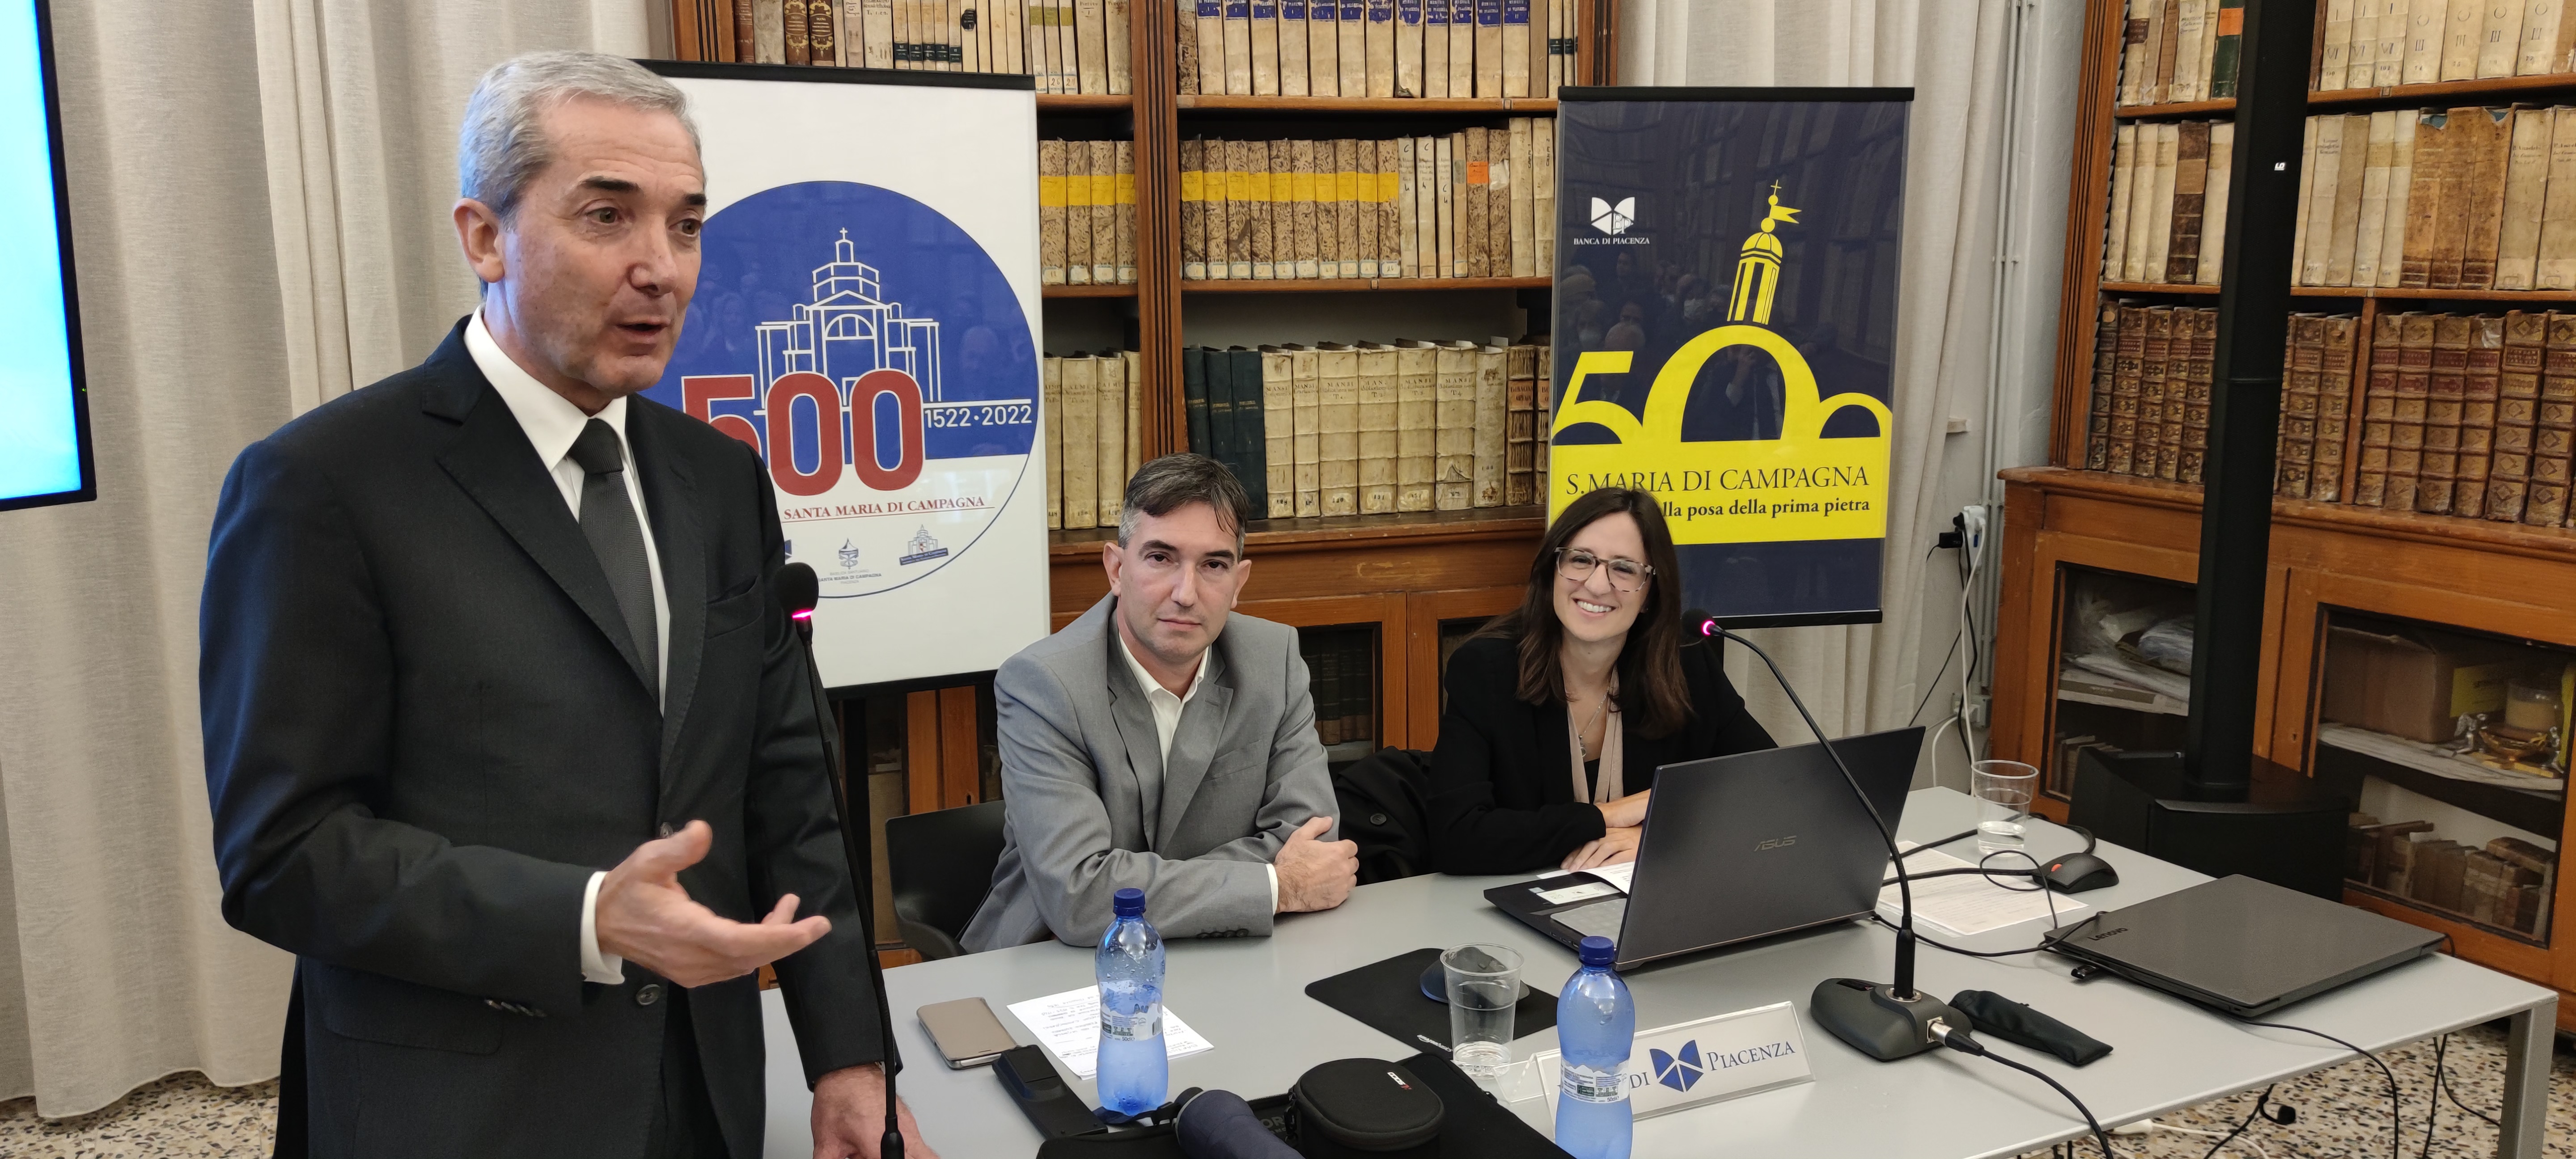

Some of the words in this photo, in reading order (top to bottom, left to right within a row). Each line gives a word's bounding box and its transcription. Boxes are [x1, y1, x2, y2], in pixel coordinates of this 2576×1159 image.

[1682, 470, 1712, 491] DI
[1720, 466, 1870, 490] CAMPAGNA
[784, 506, 831, 520] SANTA
[835, 503, 883, 516] MARIA
[887, 501, 904, 512] DI
[907, 496, 985, 512] CAMPAGNA
[1663, 501, 1682, 517] lla
[1687, 504, 1724, 521] posa
[1729, 499, 1767, 514] della
[1771, 499, 1820, 519] prima
[1823, 497, 1870, 517] pietra
[1753, 835, 1797, 852] ASUS
[2087, 928, 2128, 941] Lenovo
[1629, 1071, 1651, 1089] DI
[1706, 1041, 1796, 1071] PIACENZA
